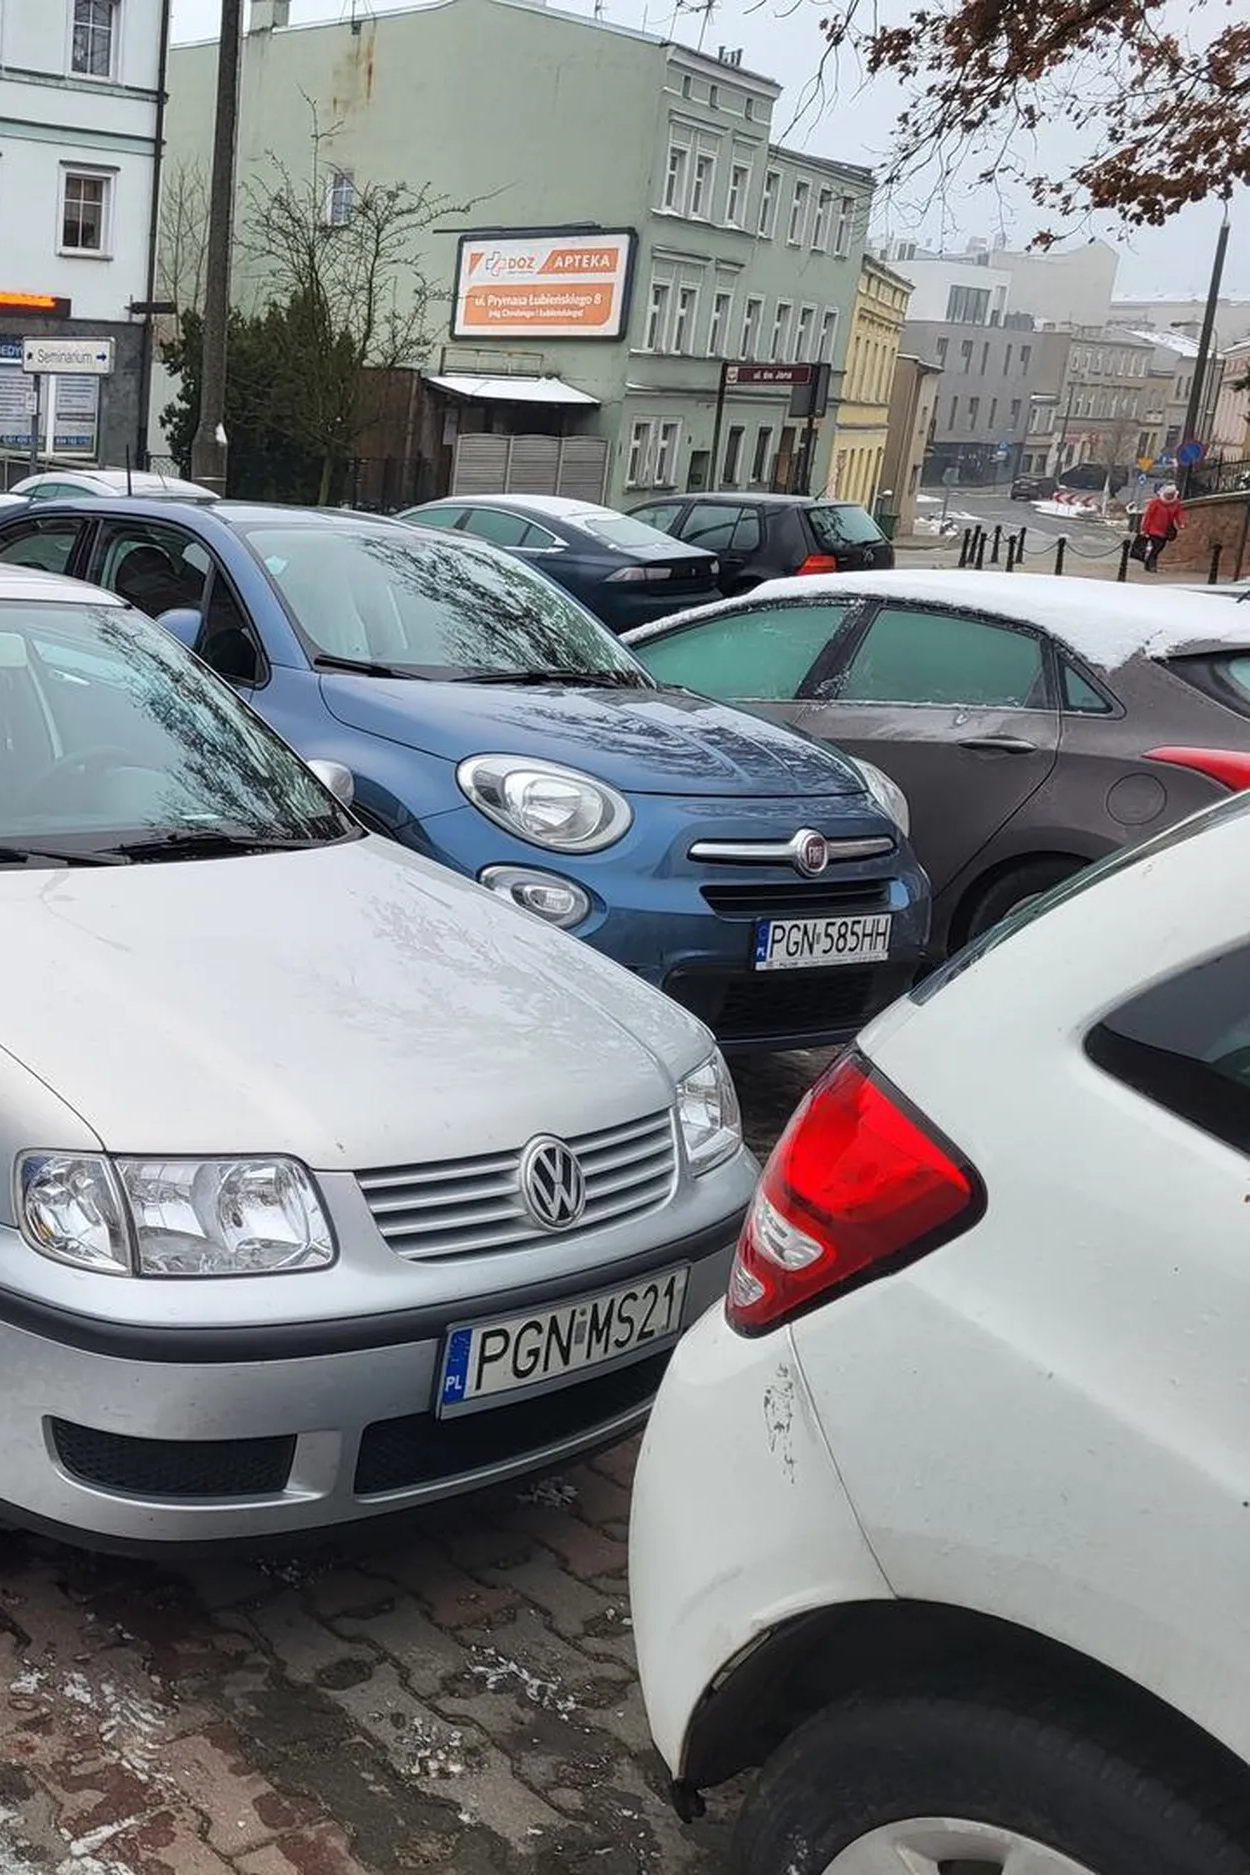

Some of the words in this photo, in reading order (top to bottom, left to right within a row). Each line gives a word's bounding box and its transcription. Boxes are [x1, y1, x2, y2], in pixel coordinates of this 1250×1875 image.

[554, 254, 611, 268] APTEKA
[475, 295, 486, 306] ul.
[488, 295, 527, 307] Prymasa
[37, 348, 92, 364] Seminarium
[769, 922, 817, 958] PGN
[822, 918, 890, 954] 585HH
[475, 1309, 576, 1390] PGN
[586, 1275, 677, 1359] MS21
[444, 1376, 462, 1392] PL
